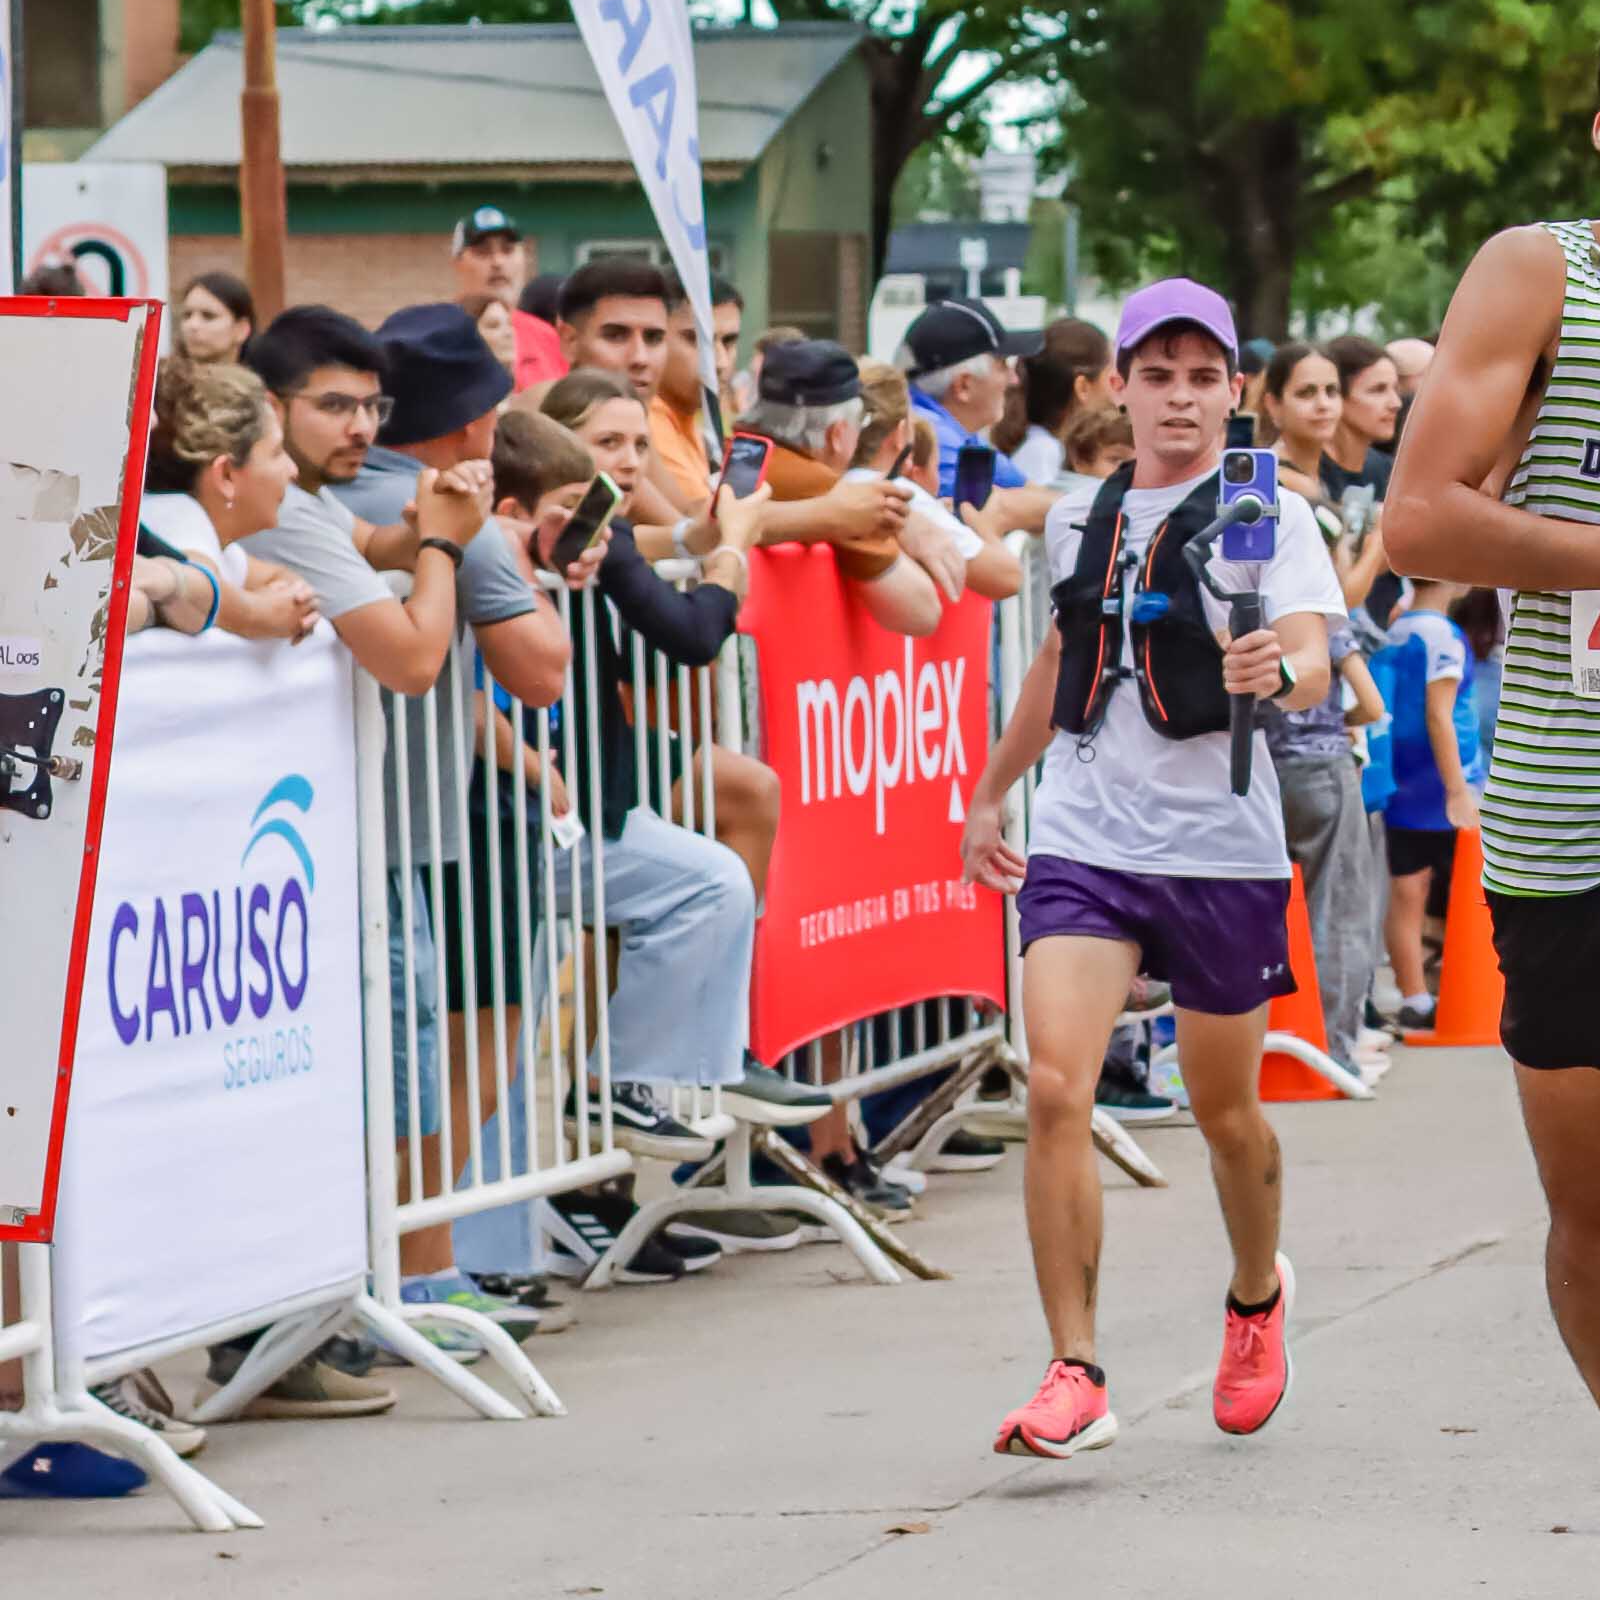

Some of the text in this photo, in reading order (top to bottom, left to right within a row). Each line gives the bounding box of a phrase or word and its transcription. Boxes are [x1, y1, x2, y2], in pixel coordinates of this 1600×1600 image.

[796, 635, 968, 836] moplex
[107, 876, 309, 1046] CARUSO
[223, 1024, 313, 1090] SEGUROS
